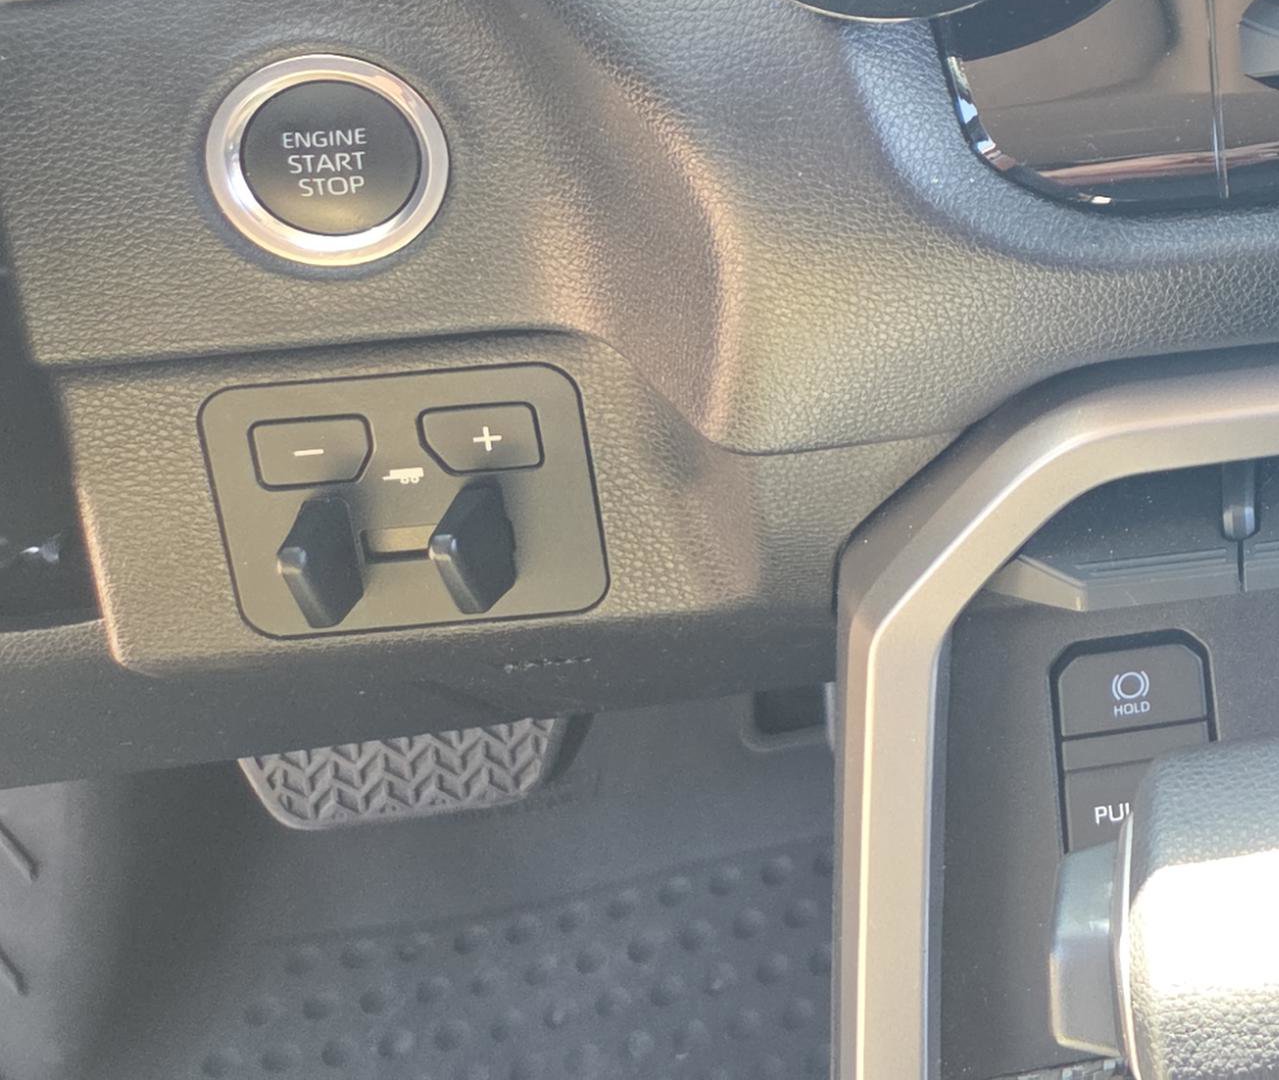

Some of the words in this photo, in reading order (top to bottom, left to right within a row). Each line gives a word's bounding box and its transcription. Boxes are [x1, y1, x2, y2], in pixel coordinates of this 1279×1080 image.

[282, 128, 367, 149] ENGINE
[287, 152, 364, 174] START
[298, 174, 365, 198] STOP
[1114, 701, 1150, 717] HOLD
